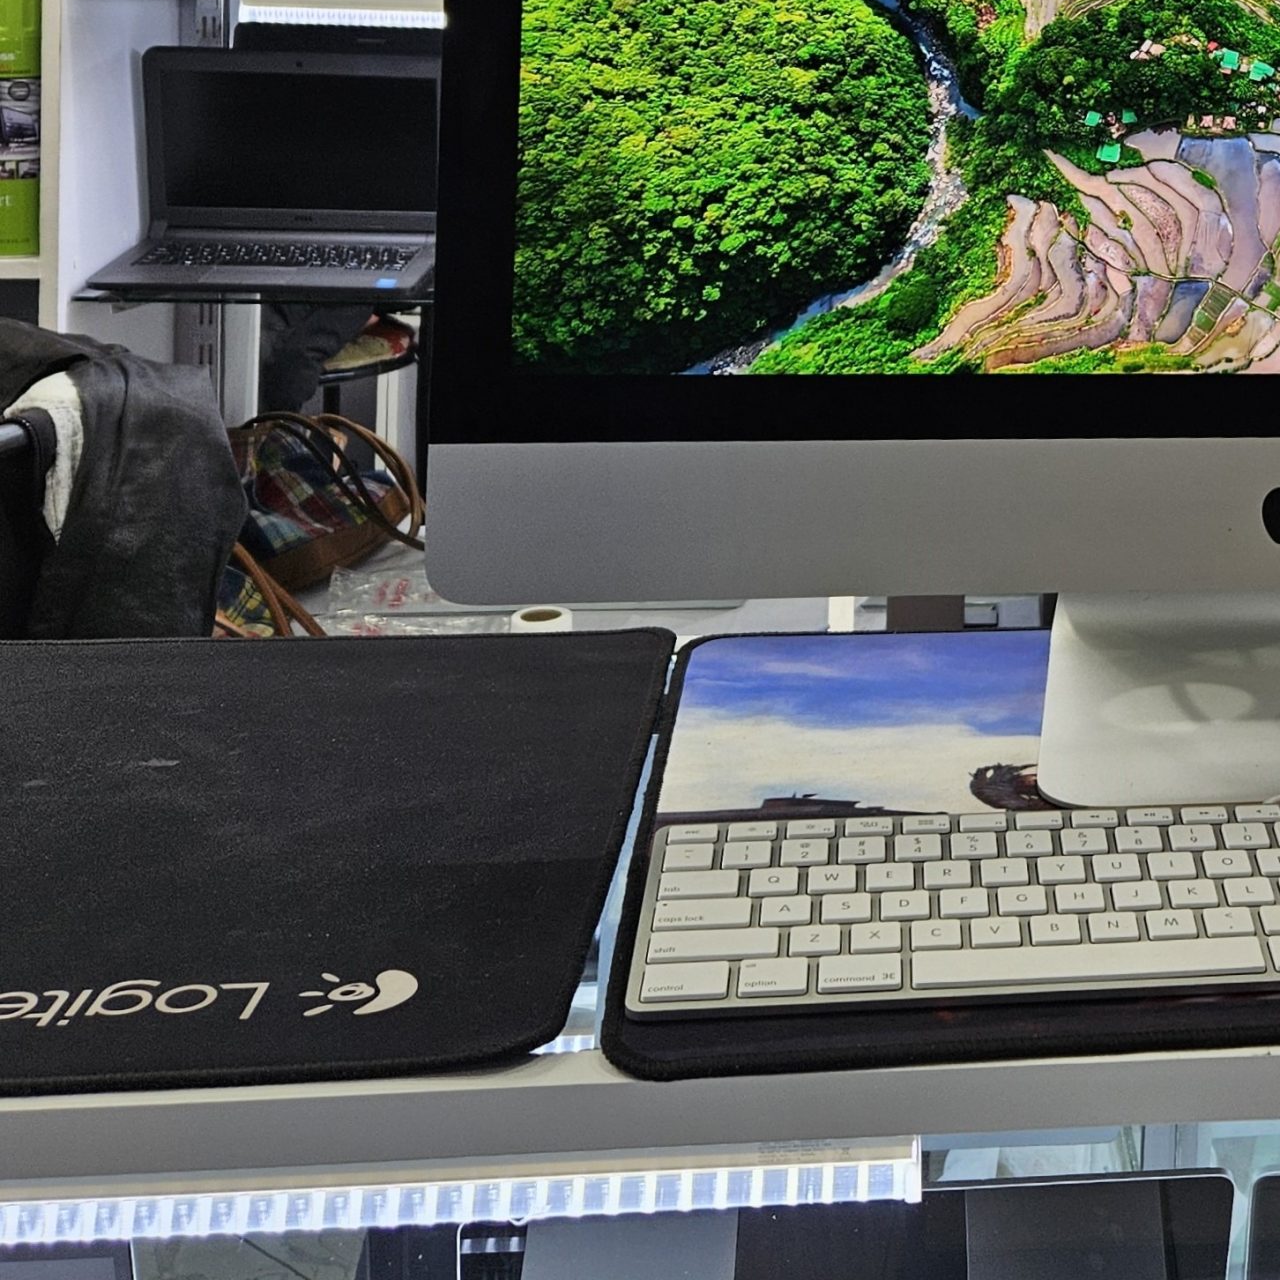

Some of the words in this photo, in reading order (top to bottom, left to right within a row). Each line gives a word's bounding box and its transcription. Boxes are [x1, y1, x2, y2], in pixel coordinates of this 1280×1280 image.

[1189, 835, 1198, 843] 9
[857, 848, 866, 856] 3
[913, 846, 922, 854] 4
[969, 844, 977, 852] 5
[800, 851, 809, 859] 2
[1111, 861, 1122, 870] U
[1221, 857, 1234, 866] O
[1001, 866, 1009, 874] T
[1056, 863, 1065, 871] Y
[886, 871, 893, 879] E
[943, 868, 952, 877] R
[768, 875, 780, 884] Q
[824, 873, 840, 882] W
[1131, 889, 1139, 898] J
[1187, 887, 1198, 896] K
[1245, 885, 1255, 894] L
[1016, 894, 1028, 902] G
[1073, 891, 1085, 900] H
[899, 898, 911, 908] D
[960, 896, 968, 905] F
[778, 904, 792, 913] A
[841, 901, 851, 911] S
[1107, 920, 1119, 929] N
[1164, 917, 1179, 927] M
[989, 925, 1000, 935] V
[1050, 922, 1060, 932] B
[868, 930, 881, 940] X
[930, 927, 942, 937] C
[809, 933, 820, 943] Z
[823, 974, 876, 984] command
[744, 979, 777, 989] option
[647, 984, 684, 994] control
